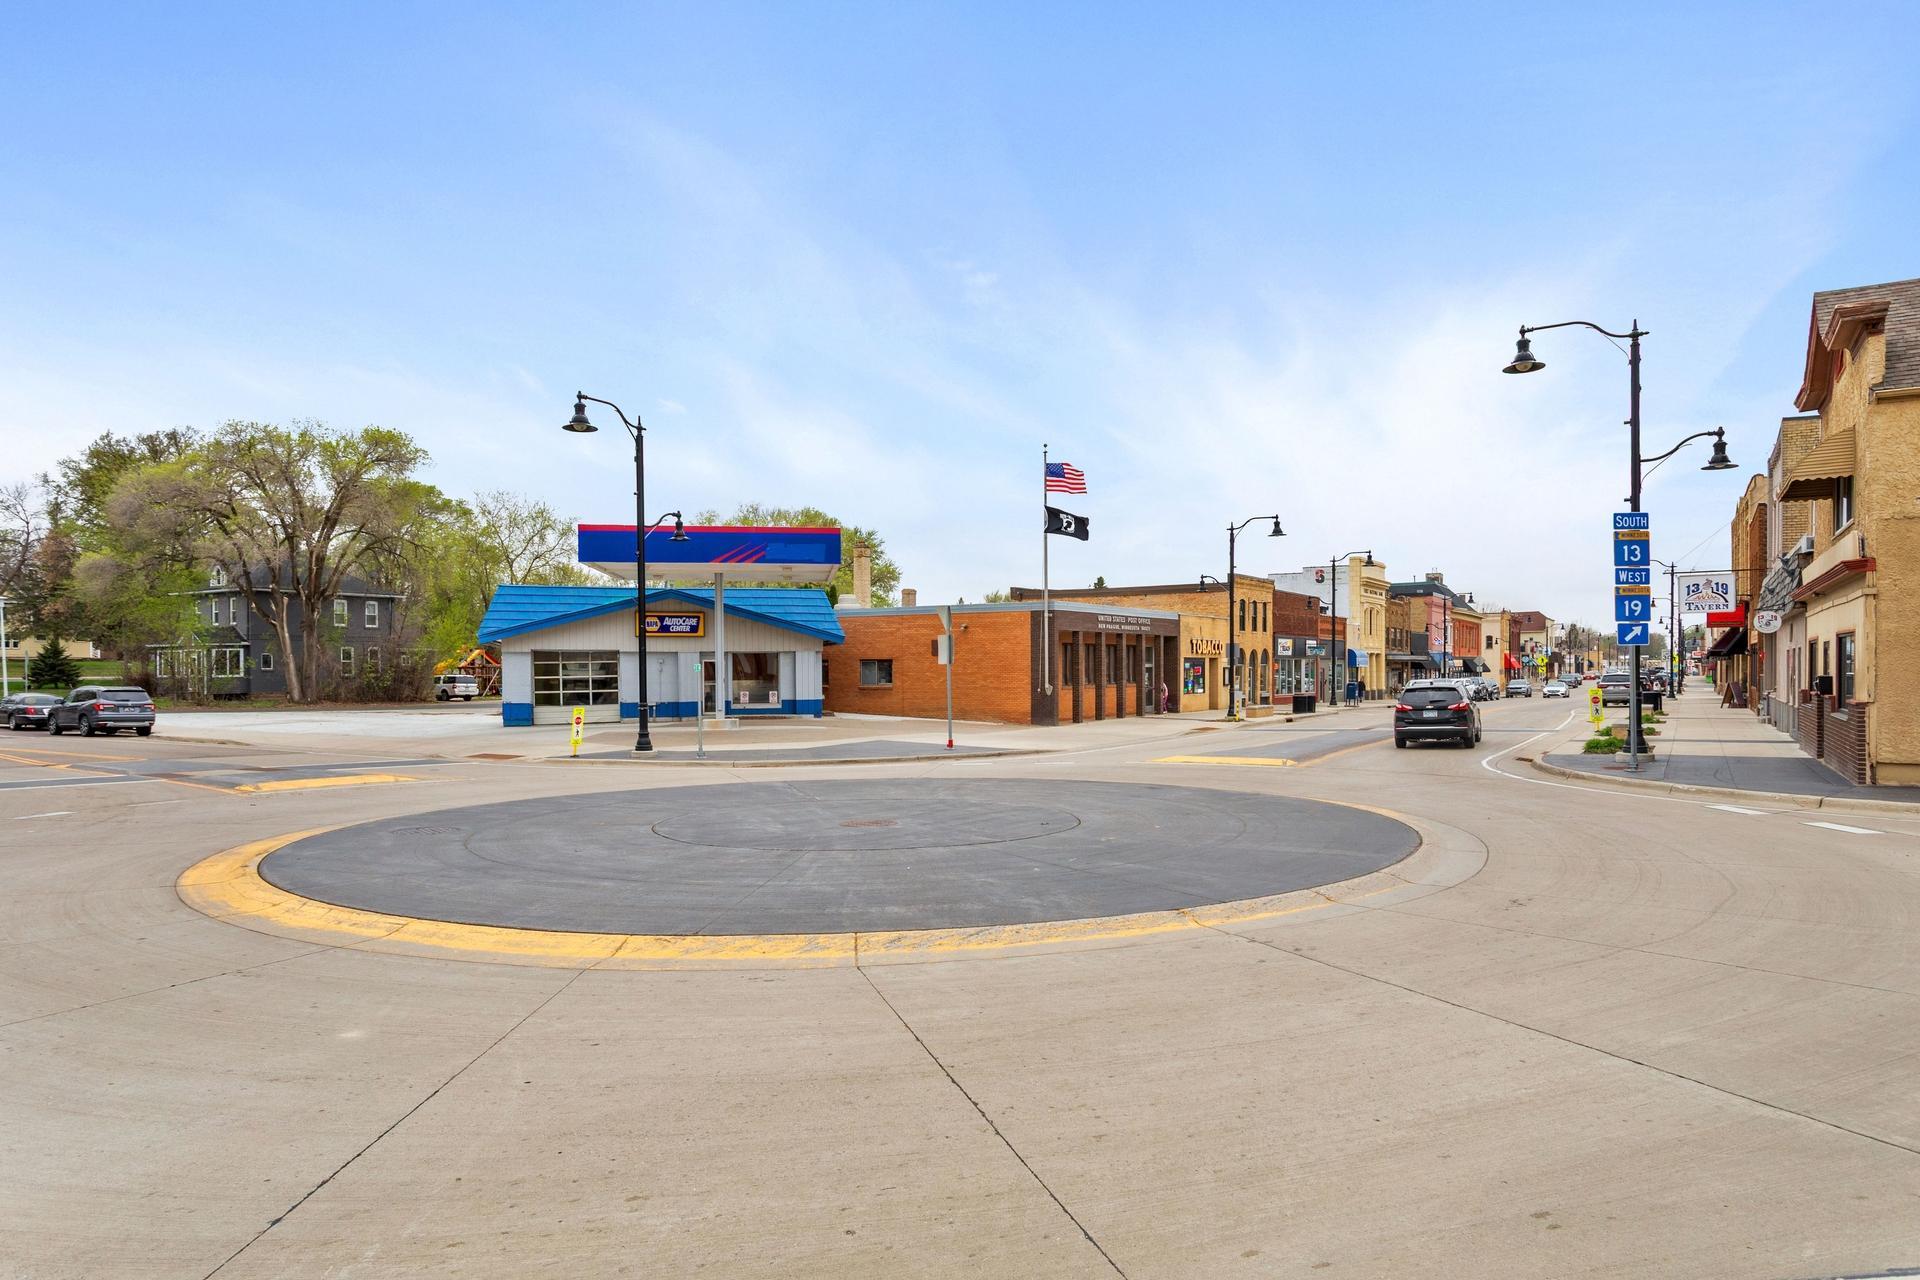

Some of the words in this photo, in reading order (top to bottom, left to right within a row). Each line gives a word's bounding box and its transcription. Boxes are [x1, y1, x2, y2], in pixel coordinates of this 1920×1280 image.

[1616, 516, 1647, 527] SOUTH
[1623, 545, 1641, 561] 13
[1619, 570, 1646, 582] WEST
[1686, 583, 1700, 596] 13
[1714, 582, 1729, 595] 19
[1624, 600, 1642, 616] 19
[1685, 602, 1729, 611] TAVERN
[1191, 639, 1223, 655] TOBACCO
